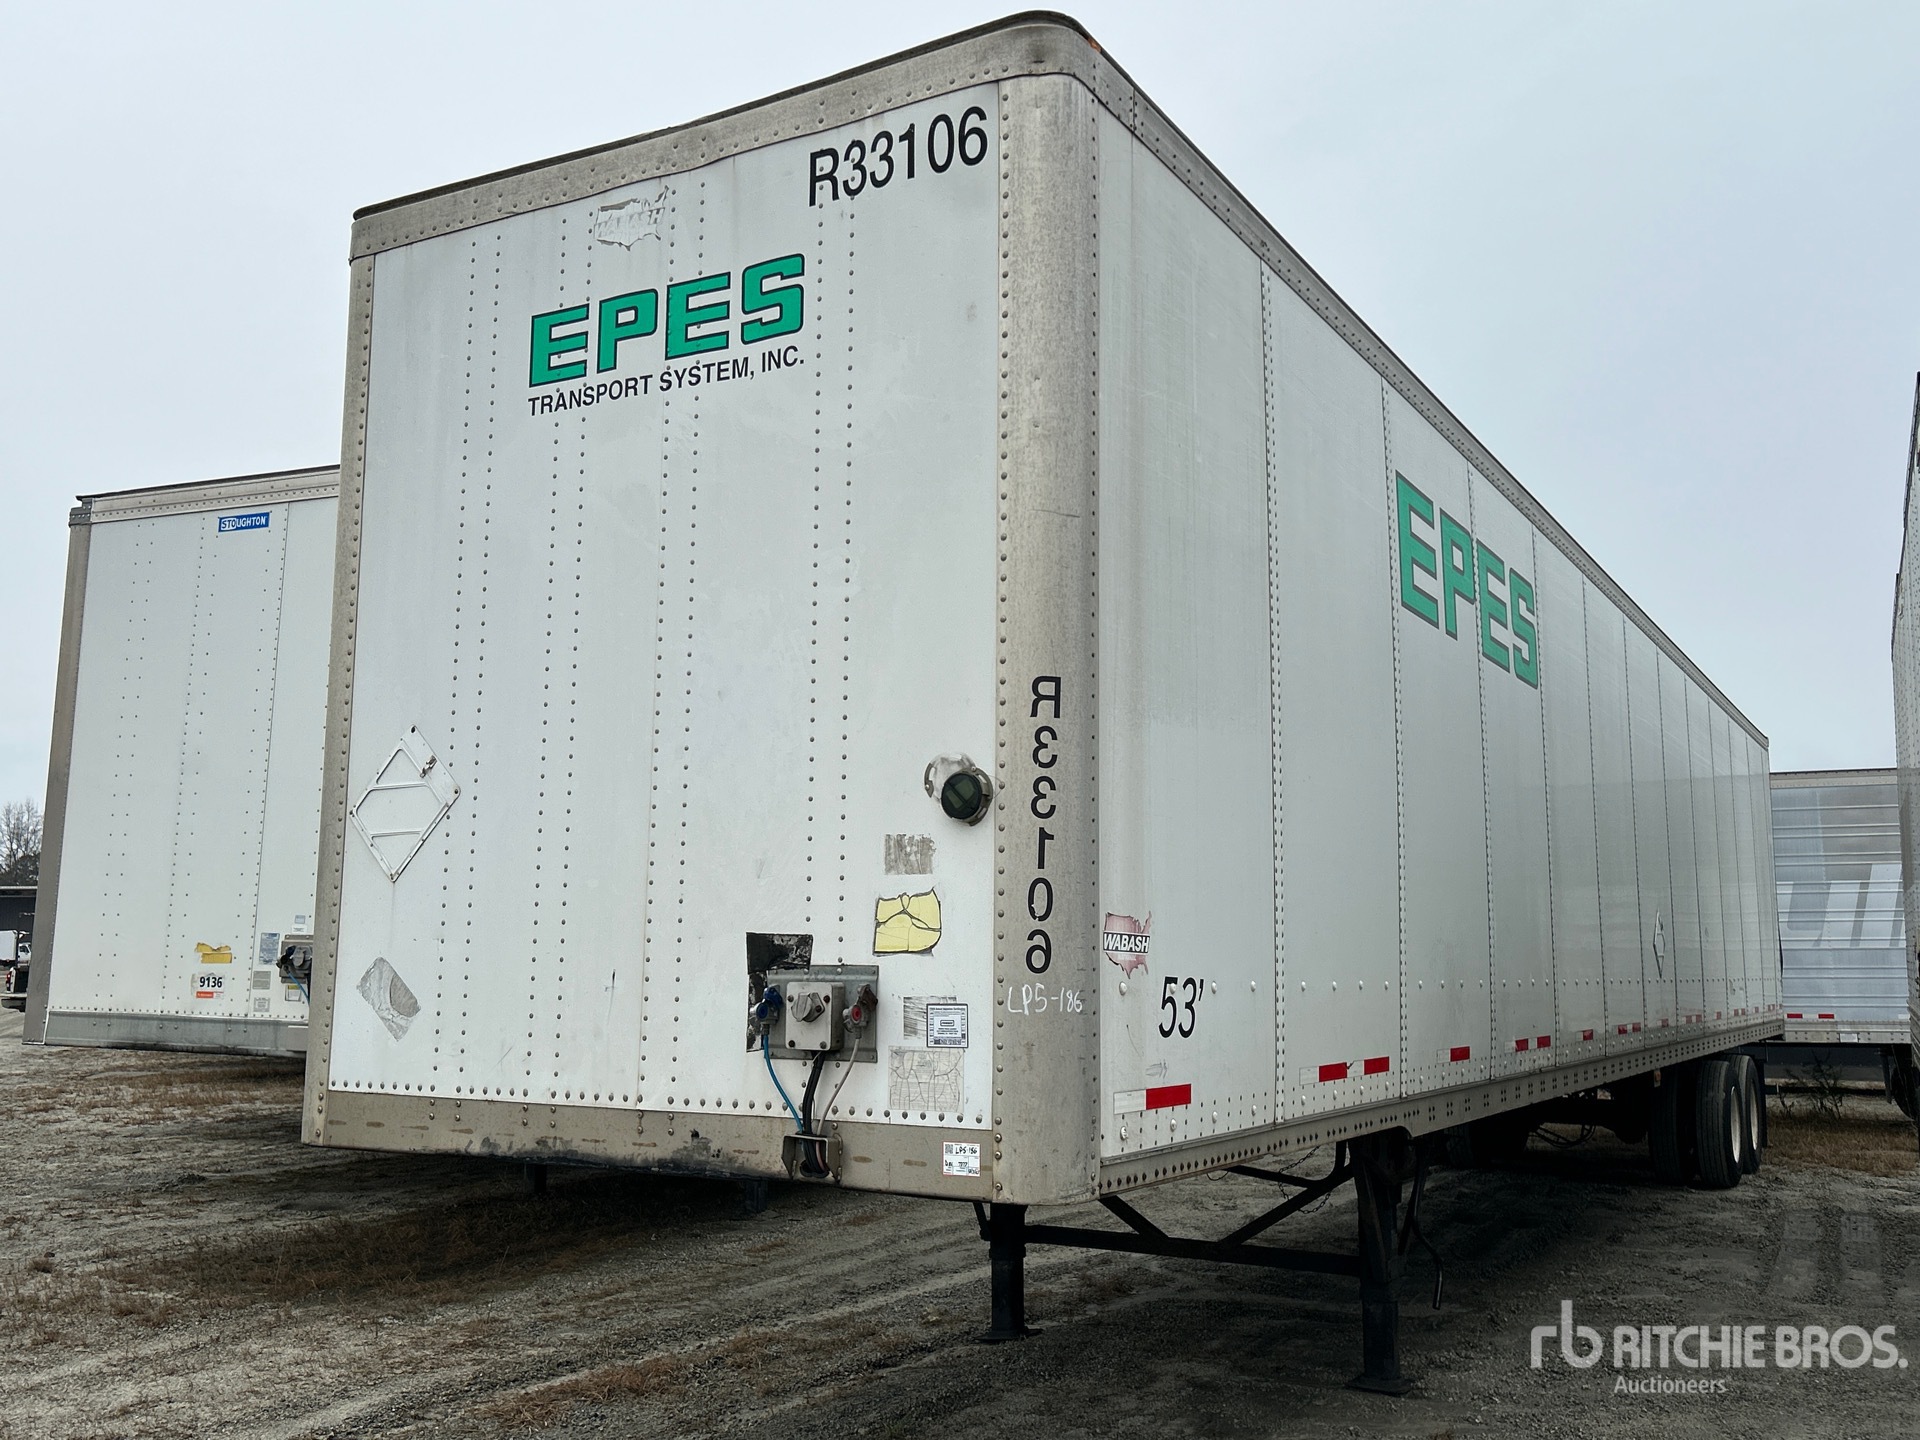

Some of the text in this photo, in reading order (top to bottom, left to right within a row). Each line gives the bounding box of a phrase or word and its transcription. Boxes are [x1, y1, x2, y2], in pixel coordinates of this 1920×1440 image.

[808, 106, 988, 206] R33106
[528, 253, 805, 388] EPES
[528, 345, 805, 417] TRANSPORT SYSTEM, INC.
[221, 516, 267, 529] STOUGHTON
[1396, 471, 1539, 690] EPES
[1104, 933, 1150, 953] WABASH
[199, 976, 223, 989] 9136
[1158, 976, 1204, 1038] 53'
